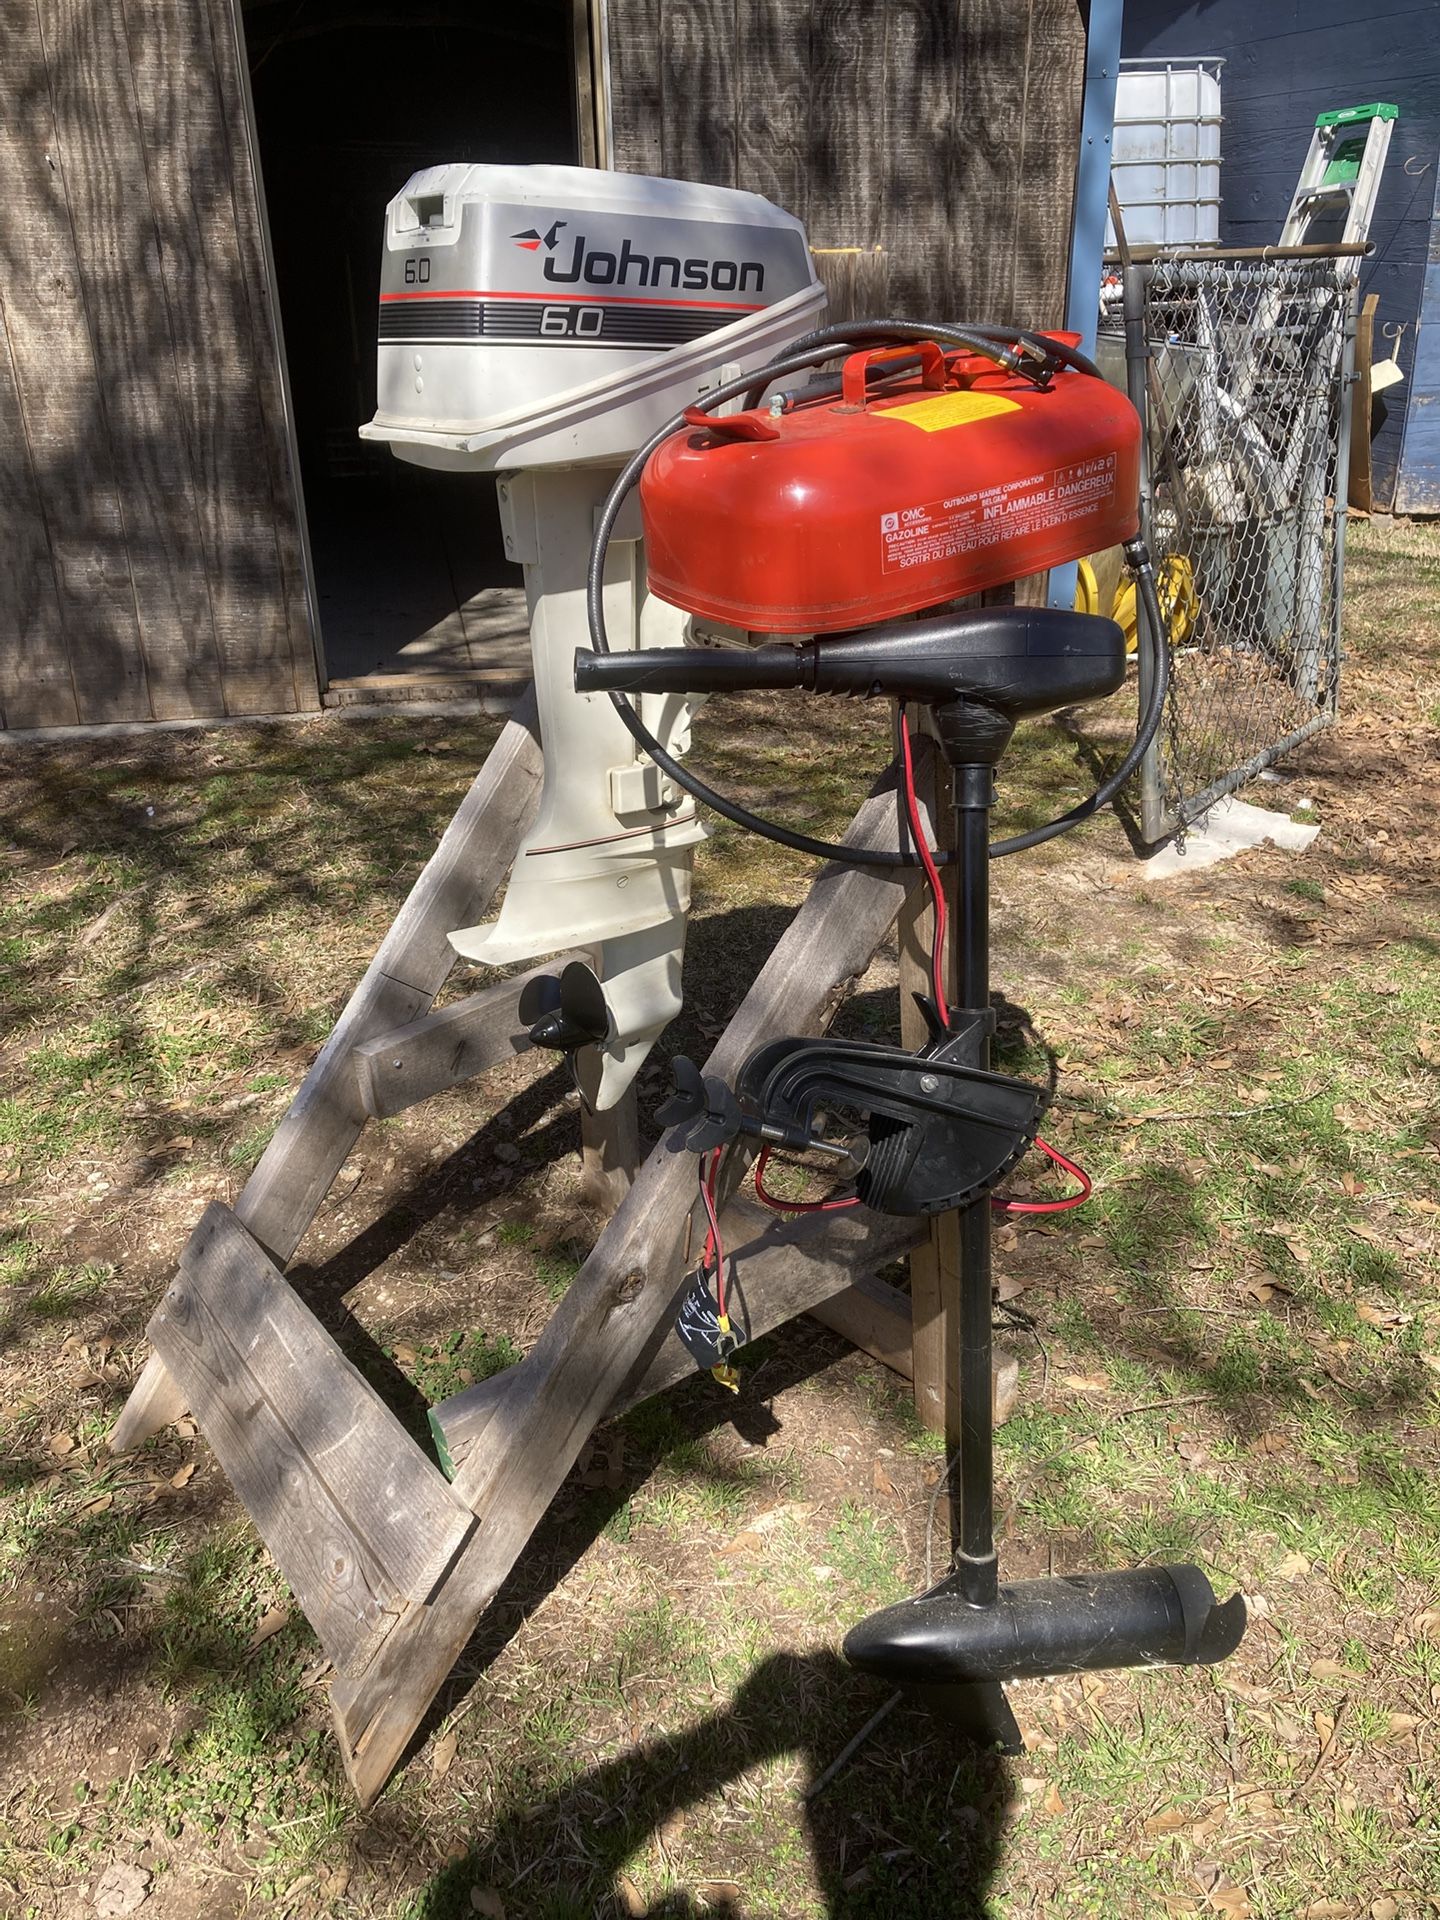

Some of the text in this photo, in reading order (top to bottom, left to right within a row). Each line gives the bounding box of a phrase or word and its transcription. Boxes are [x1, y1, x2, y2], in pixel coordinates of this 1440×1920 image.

[405, 257, 431, 284] 6.0
[543, 236, 764, 292] Johnson
[540, 306, 605, 337] 6.0
[943, 474, 1045, 509] OUTBOARD MARINE CORPORATION
[981, 493, 1008, 507] BELGIUM
[983, 488, 1056, 520] INFLAMMABLE
[1057, 472, 1114, 499] DANGEREUX
[901, 507, 926, 522] OMC
[885, 524, 930, 543] GAZOLINE
[899, 552, 931, 568] SORTIR
[932, 549, 944, 560] DU
[945, 541, 977, 557] BATEAU
[978, 533, 1000, 547] POUR
[1000, 524, 1031, 541] REFAIRE
[1031, 521, 1041, 532] LE
[1042, 513, 1062, 528] PLEIN
